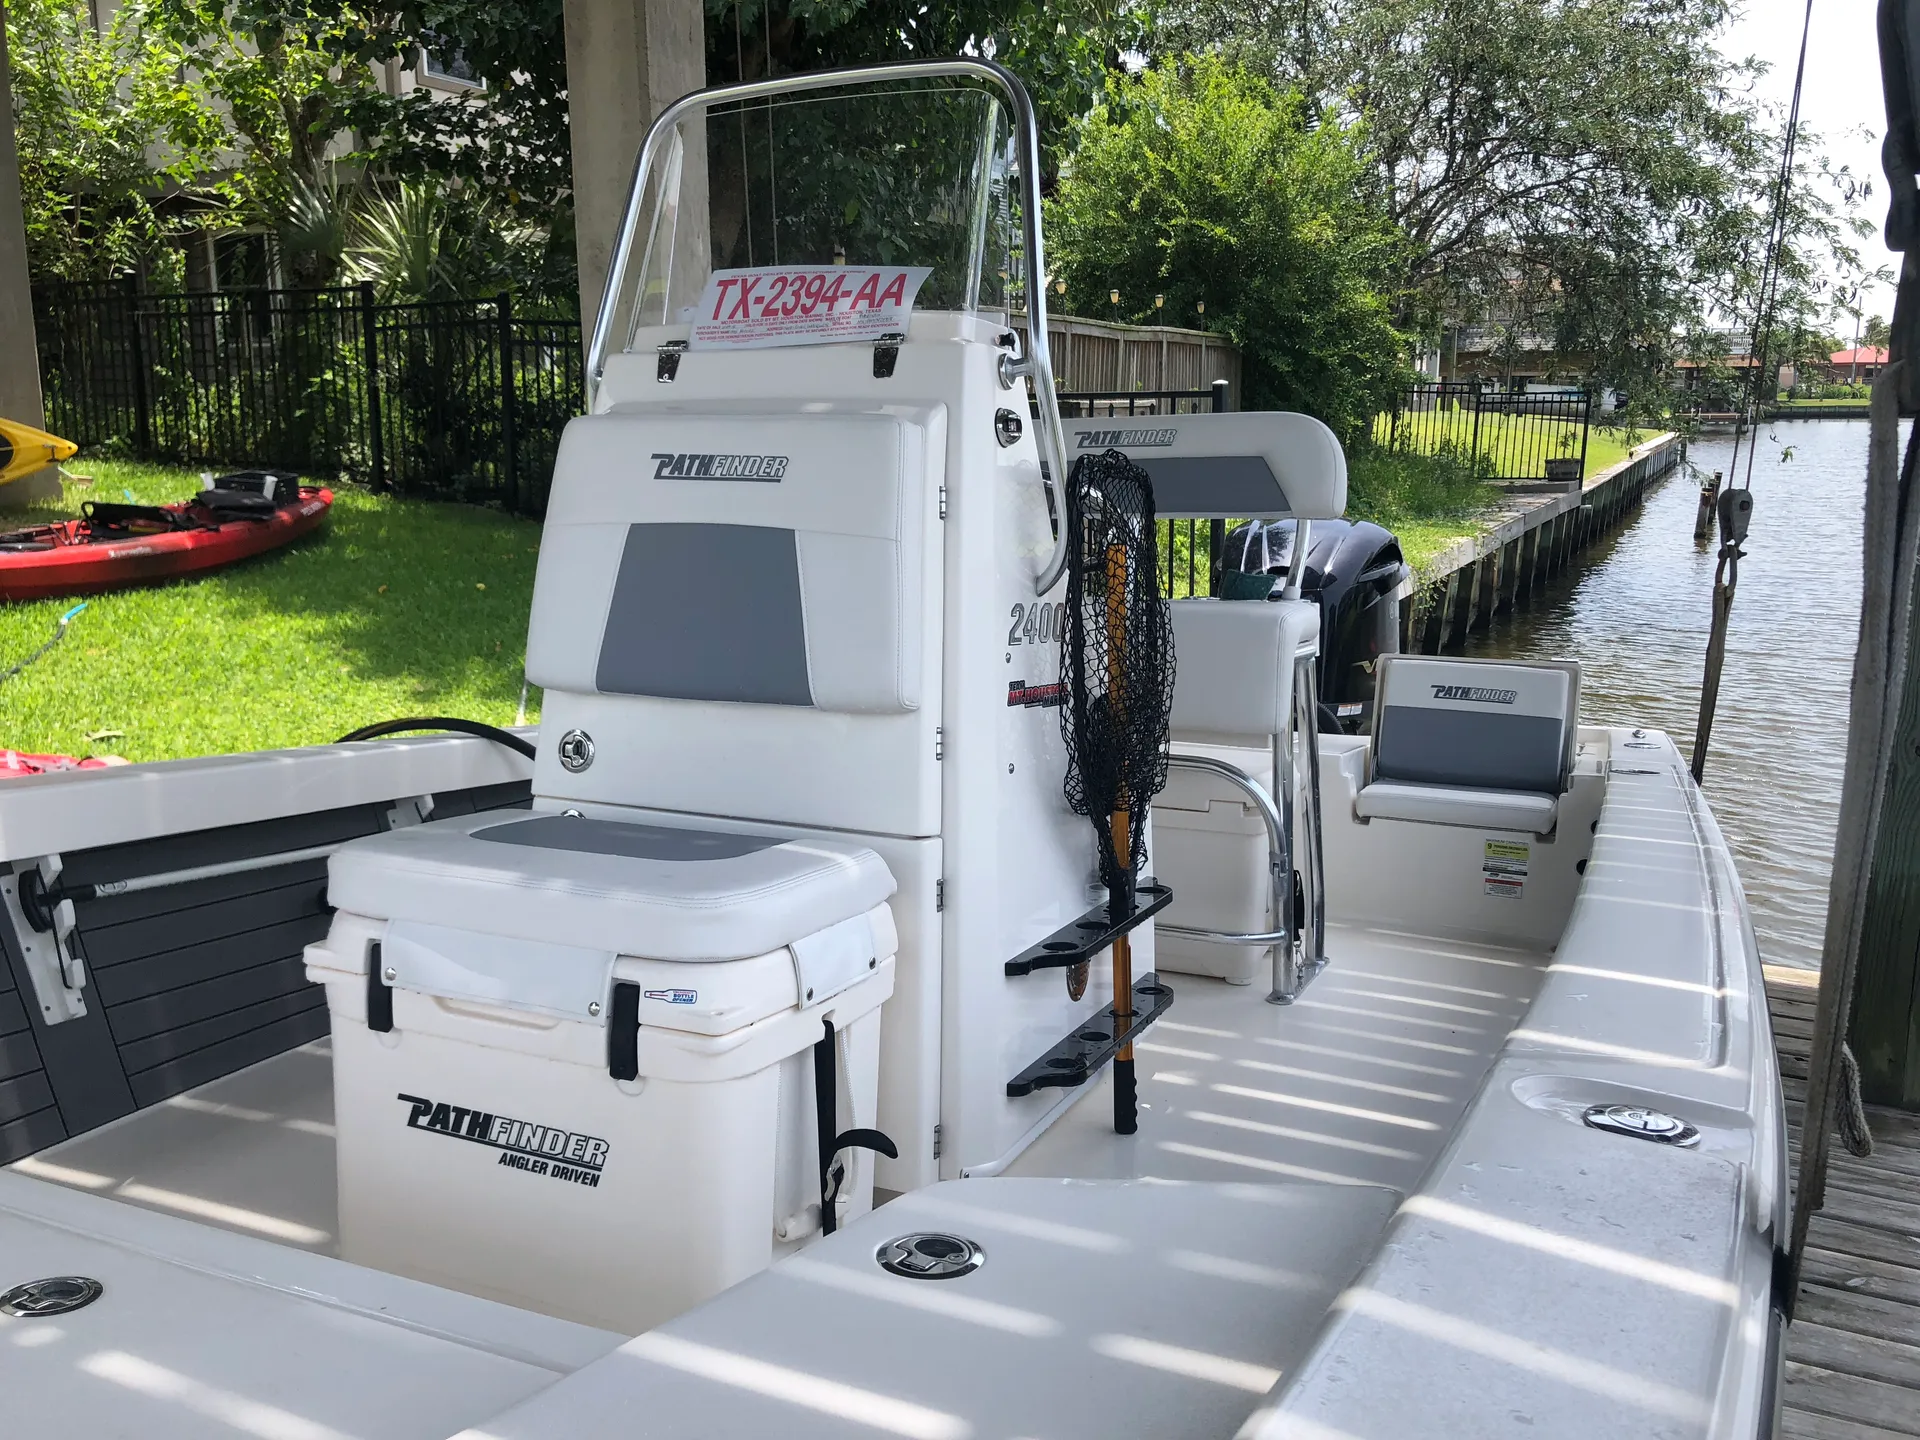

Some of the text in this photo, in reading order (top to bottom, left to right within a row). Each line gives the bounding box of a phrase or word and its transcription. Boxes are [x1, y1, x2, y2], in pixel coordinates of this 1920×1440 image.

[712, 273, 908, 321] TX-2394-AA
[1074, 429, 1178, 448] PATHFINDER
[650, 453, 789, 483] PATHFINDER
[1008, 602, 1065, 646] 2400
[1430, 684, 1517, 704] PATHFINDER
[398, 1092, 610, 1172] PATHFINDER
[498, 1152, 600, 1188] ANGLER DRIVEN
